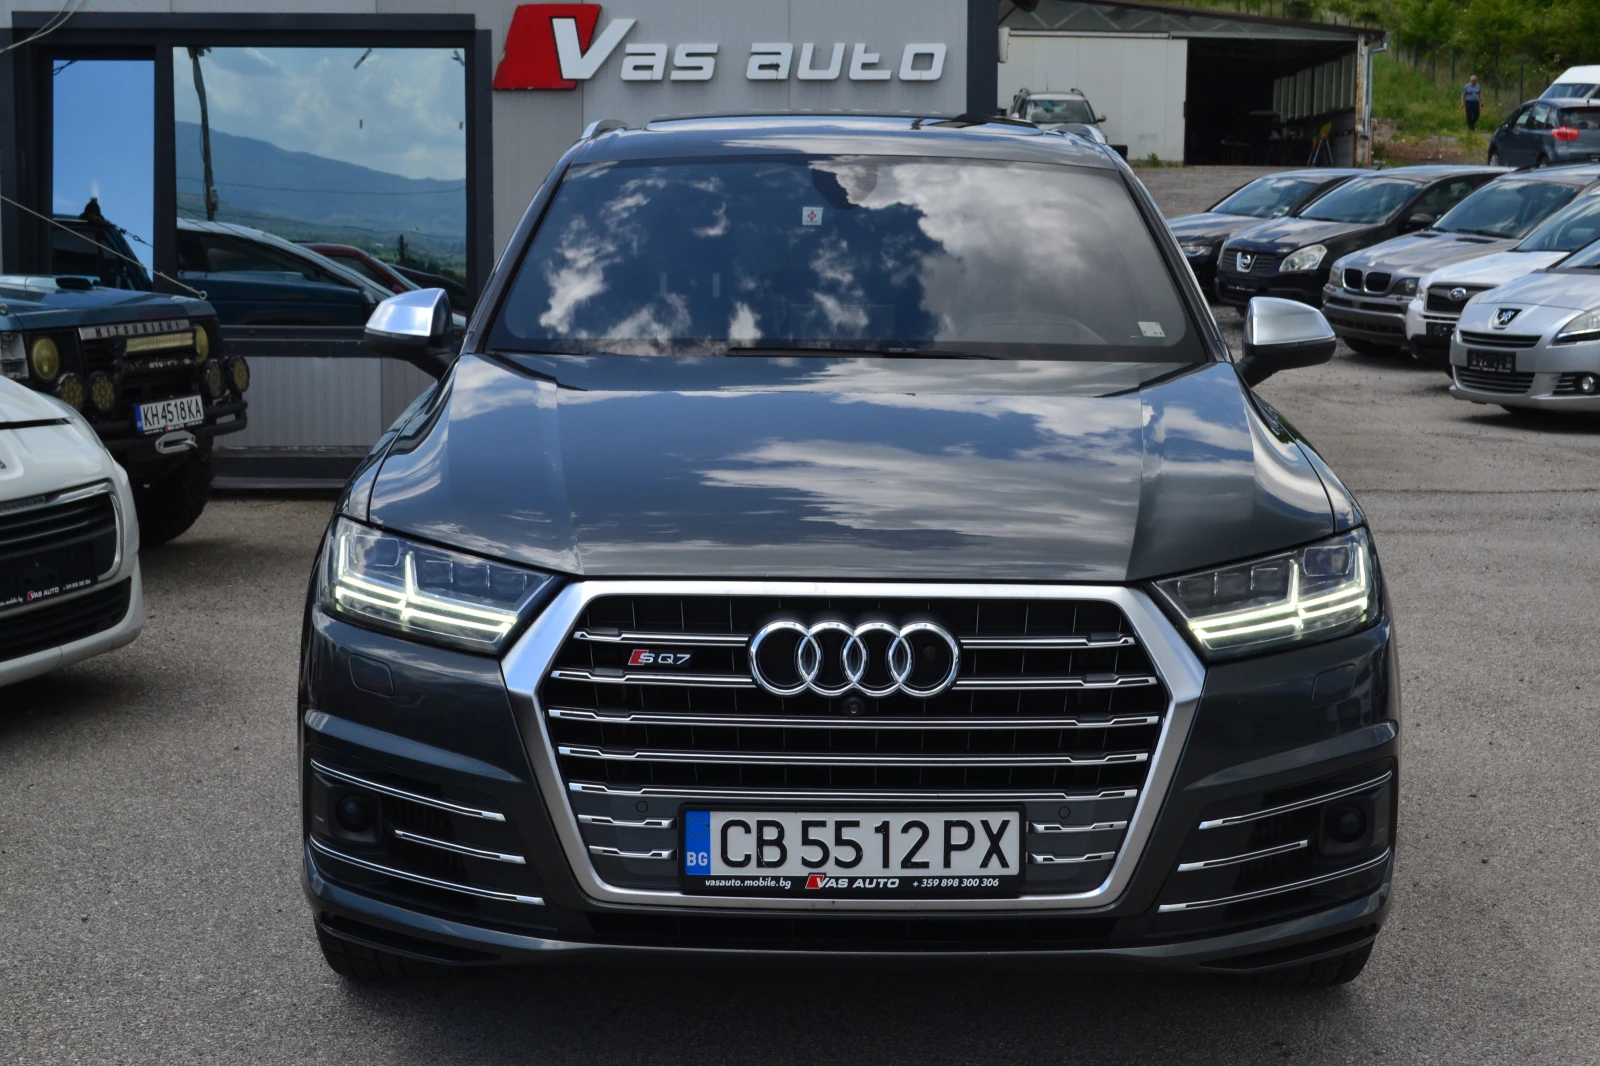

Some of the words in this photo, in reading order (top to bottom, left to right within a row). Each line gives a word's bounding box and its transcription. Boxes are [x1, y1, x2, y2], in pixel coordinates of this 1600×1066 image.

[550, 17, 719, 81] Vas
[745, 42, 947, 81] auto
[95, 321, 179, 337] MITSUBISHI
[686, 851, 709, 867] BG
[705, 877, 792, 889] vasauto.mobile.bg
[817, 877, 849, 889] VAS
[852, 878, 900, 889] AUTO
[940, 878, 959, 887] 898
[960, 878, 980, 887] 300
[980, 878, 999, 887] 306
